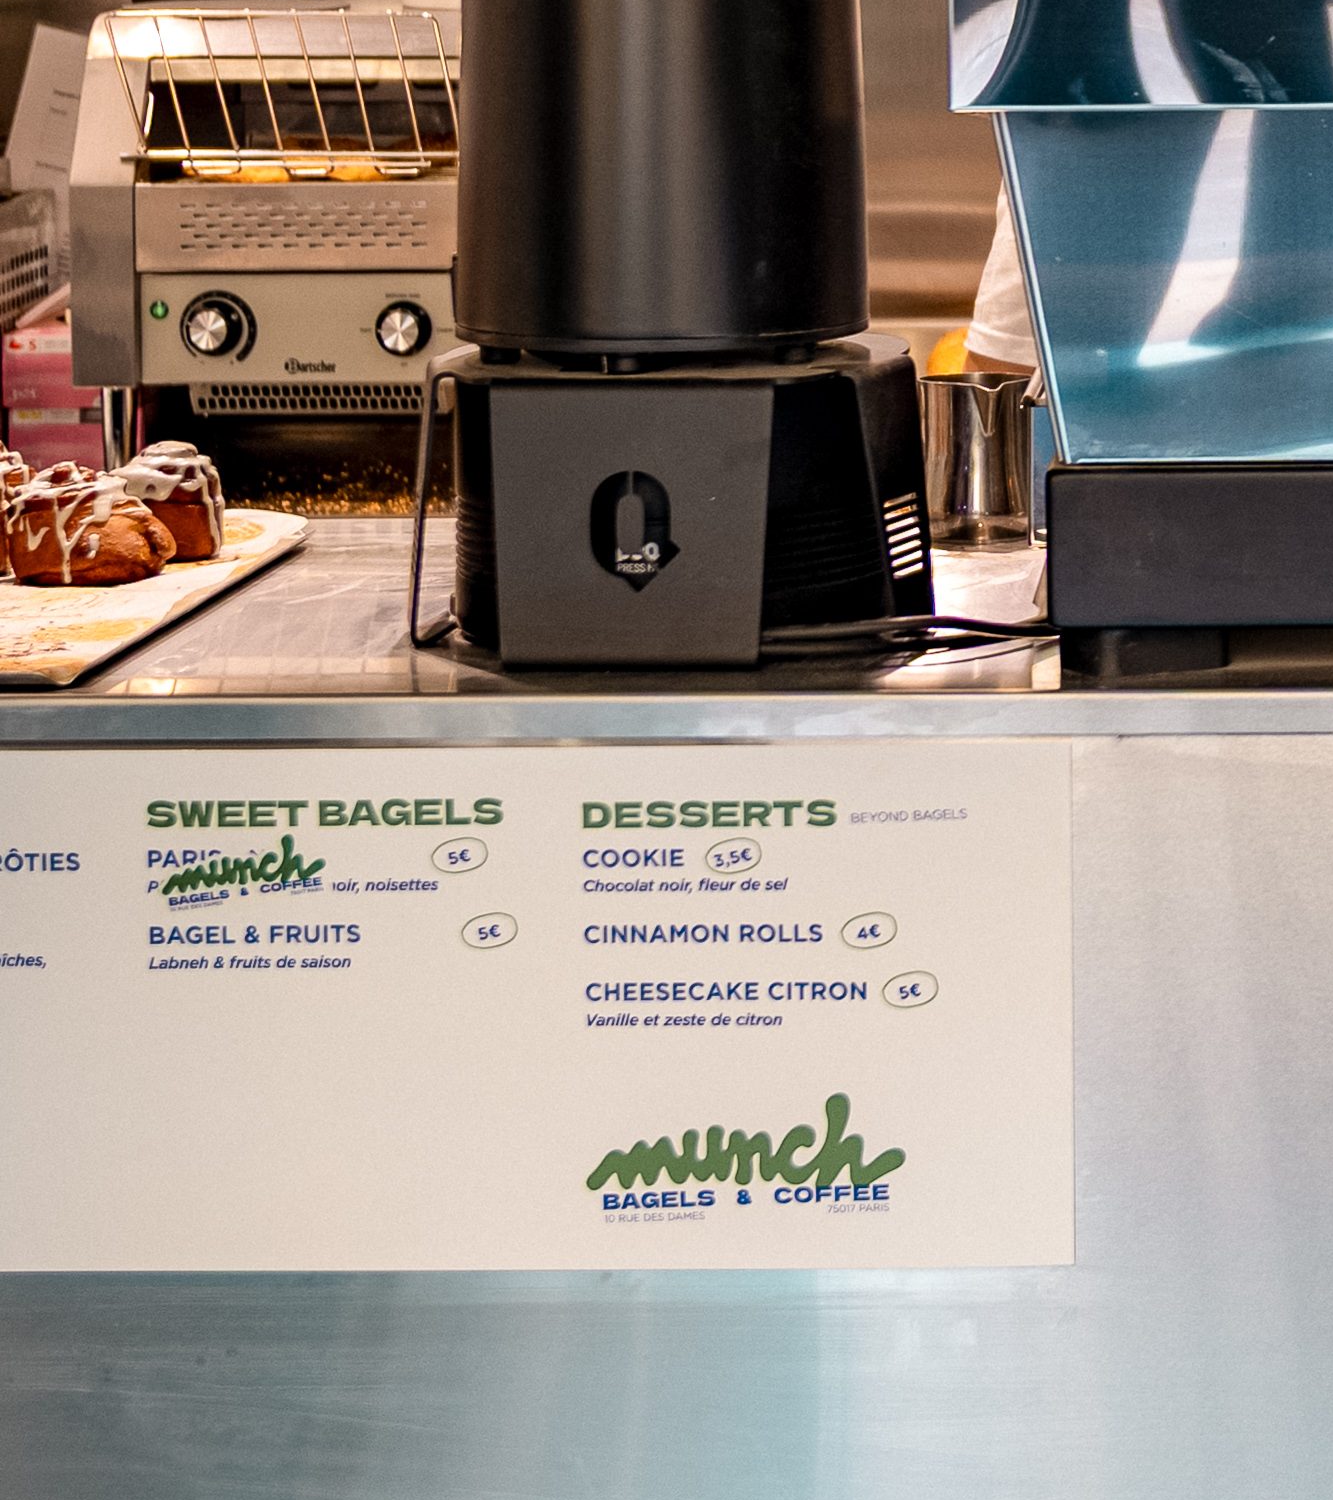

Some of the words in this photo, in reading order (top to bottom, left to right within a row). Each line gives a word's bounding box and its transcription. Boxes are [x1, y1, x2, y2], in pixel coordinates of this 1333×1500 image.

[284, 357, 336, 374] Bartscher
[617, 563, 645, 573] PRESS
[146, 799, 309, 828] SWEET
[318, 798, 503, 826] BAGELS
[582, 799, 837, 829] DESSERTS
[849, 810, 909, 824] BEYOND
[912, 807, 968, 822] BAGELS
[161, 834, 326, 895] munch
[448, 848, 471, 866] 5€
[582, 849, 685, 869] COOKIE
[713, 847, 752, 868] 3,5€
[168, 889, 230, 907] BAGELS
[260, 876, 323, 893] COFFEE
[365, 878, 439, 892] noisettes
[582, 878, 655, 893] Chocolat
[658, 878, 692, 895] noir,
[698, 878, 736, 893] fleur
[740, 877, 761, 892] de
[764, 877, 788, 892] sel
[149, 925, 236, 946] BAGEL
[244, 925, 260, 945] &
[269, 924, 361, 945] FRUITS
[478, 923, 501, 941] 5€
[583, 923, 729, 945] CINNAMON
[739, 924, 823, 943] ROLLS
[857, 923, 881, 940] 4€
[148, 956, 209, 970] Labneh
[213, 956, 224, 970] &
[229, 955, 271, 970] fruits
[276, 955, 297, 969] de
[300, 955, 351, 968] saison
[585, 981, 759, 1002] CHEESECAKE
[768, 982, 867, 1002] CITRON
[899, 982, 921, 999] 5€
[586, 1013, 639, 1027] Vanille
[643, 1014, 660, 1027] et
[663, 1013, 706, 1027] zeste
[710, 1012, 731, 1027] de
[735, 1012, 783, 1026] citron
[586, 1091, 906, 1190] munch
[603, 1189, 715, 1210] BAGELS
[736, 1189, 752, 1206] &
[774, 1184, 890, 1204] COFFEE
[604, 1214, 615, 1223] 10
[618, 1213, 640, 1222] RUE
[643, 1212, 665, 1221] DES
[668, 1211, 706, 1221] DAMES
[828, 1204, 856, 1213] 75017
[859, 1203, 890, 1212] PARIS
